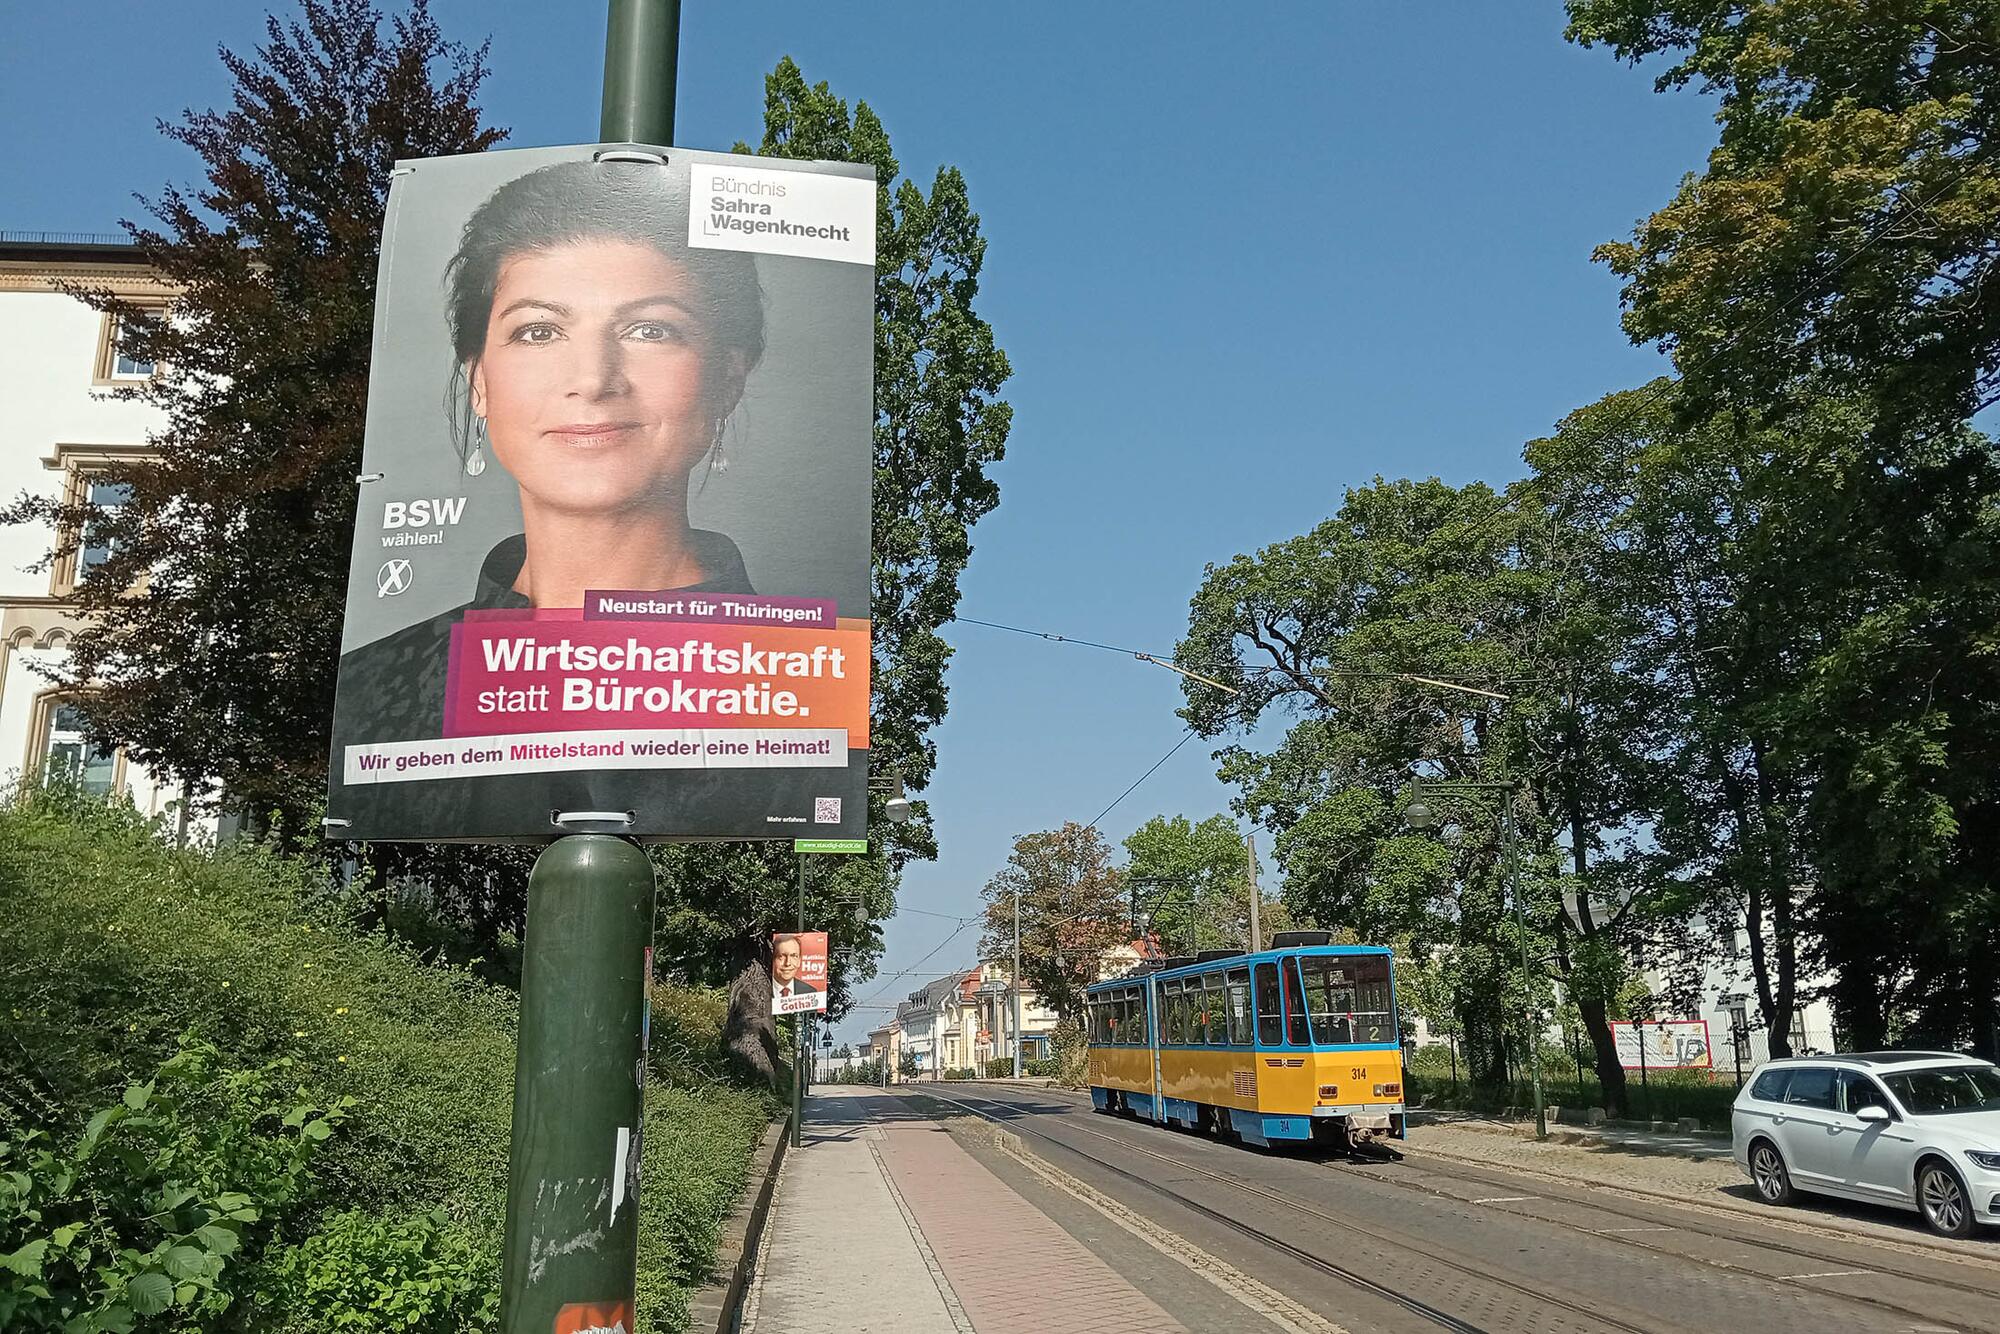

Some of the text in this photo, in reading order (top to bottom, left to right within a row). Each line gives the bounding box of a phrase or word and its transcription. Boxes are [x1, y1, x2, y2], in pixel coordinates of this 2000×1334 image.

[712, 177, 786, 197] Bündnis
[711, 196, 771, 215] Sahra
[711, 214, 850, 241] Wagenknecht
[383, 498, 467, 529] BSW
[381, 531, 444, 547] wählen!
[599, 598, 823, 622] Neustart für Thüringen!
[481, 638, 845, 679] Wirtschaftskraft
[476, 678, 810, 717] statt Bürokratie.
[359, 739, 830, 772] Wir geben dem Mittelstand wieder eine Heimat!
[801, 961, 825, 974] Hey
[781, 1001, 811, 1010] Gotha
[1369, 1026, 1379, 1040] 2
[1351, 1068, 1366, 1080] 314
[1280, 1120, 1290, 1133] 314
